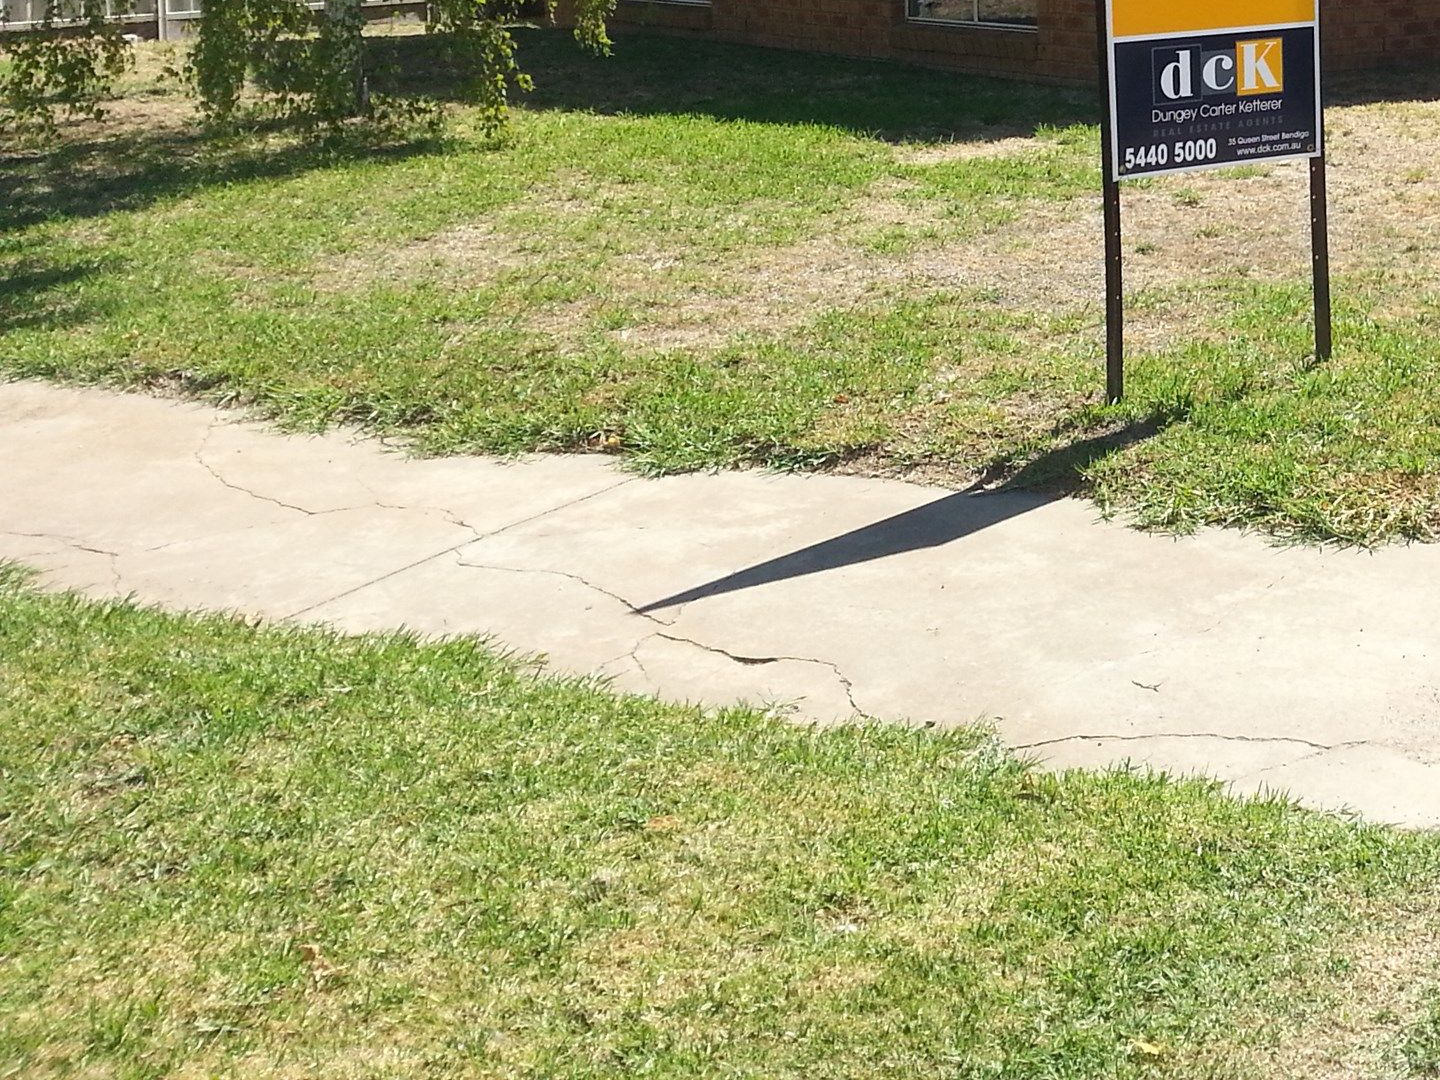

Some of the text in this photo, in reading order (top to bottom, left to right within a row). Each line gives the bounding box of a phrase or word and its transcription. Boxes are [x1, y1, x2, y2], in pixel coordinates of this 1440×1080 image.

[1152, 99, 1283, 123] Dungey Carter Ketterer
[1153, 115, 1284, 137] REAL ESTATE AGENTS
[1237, 135, 1260, 145] Queen
[1261, 133, 1280, 142] Street
[1281, 130, 1309, 141] Bendigo
[1125, 138, 1217, 169] 5440 5000
[1236, 142, 1301, 156] www.dck.com.au
